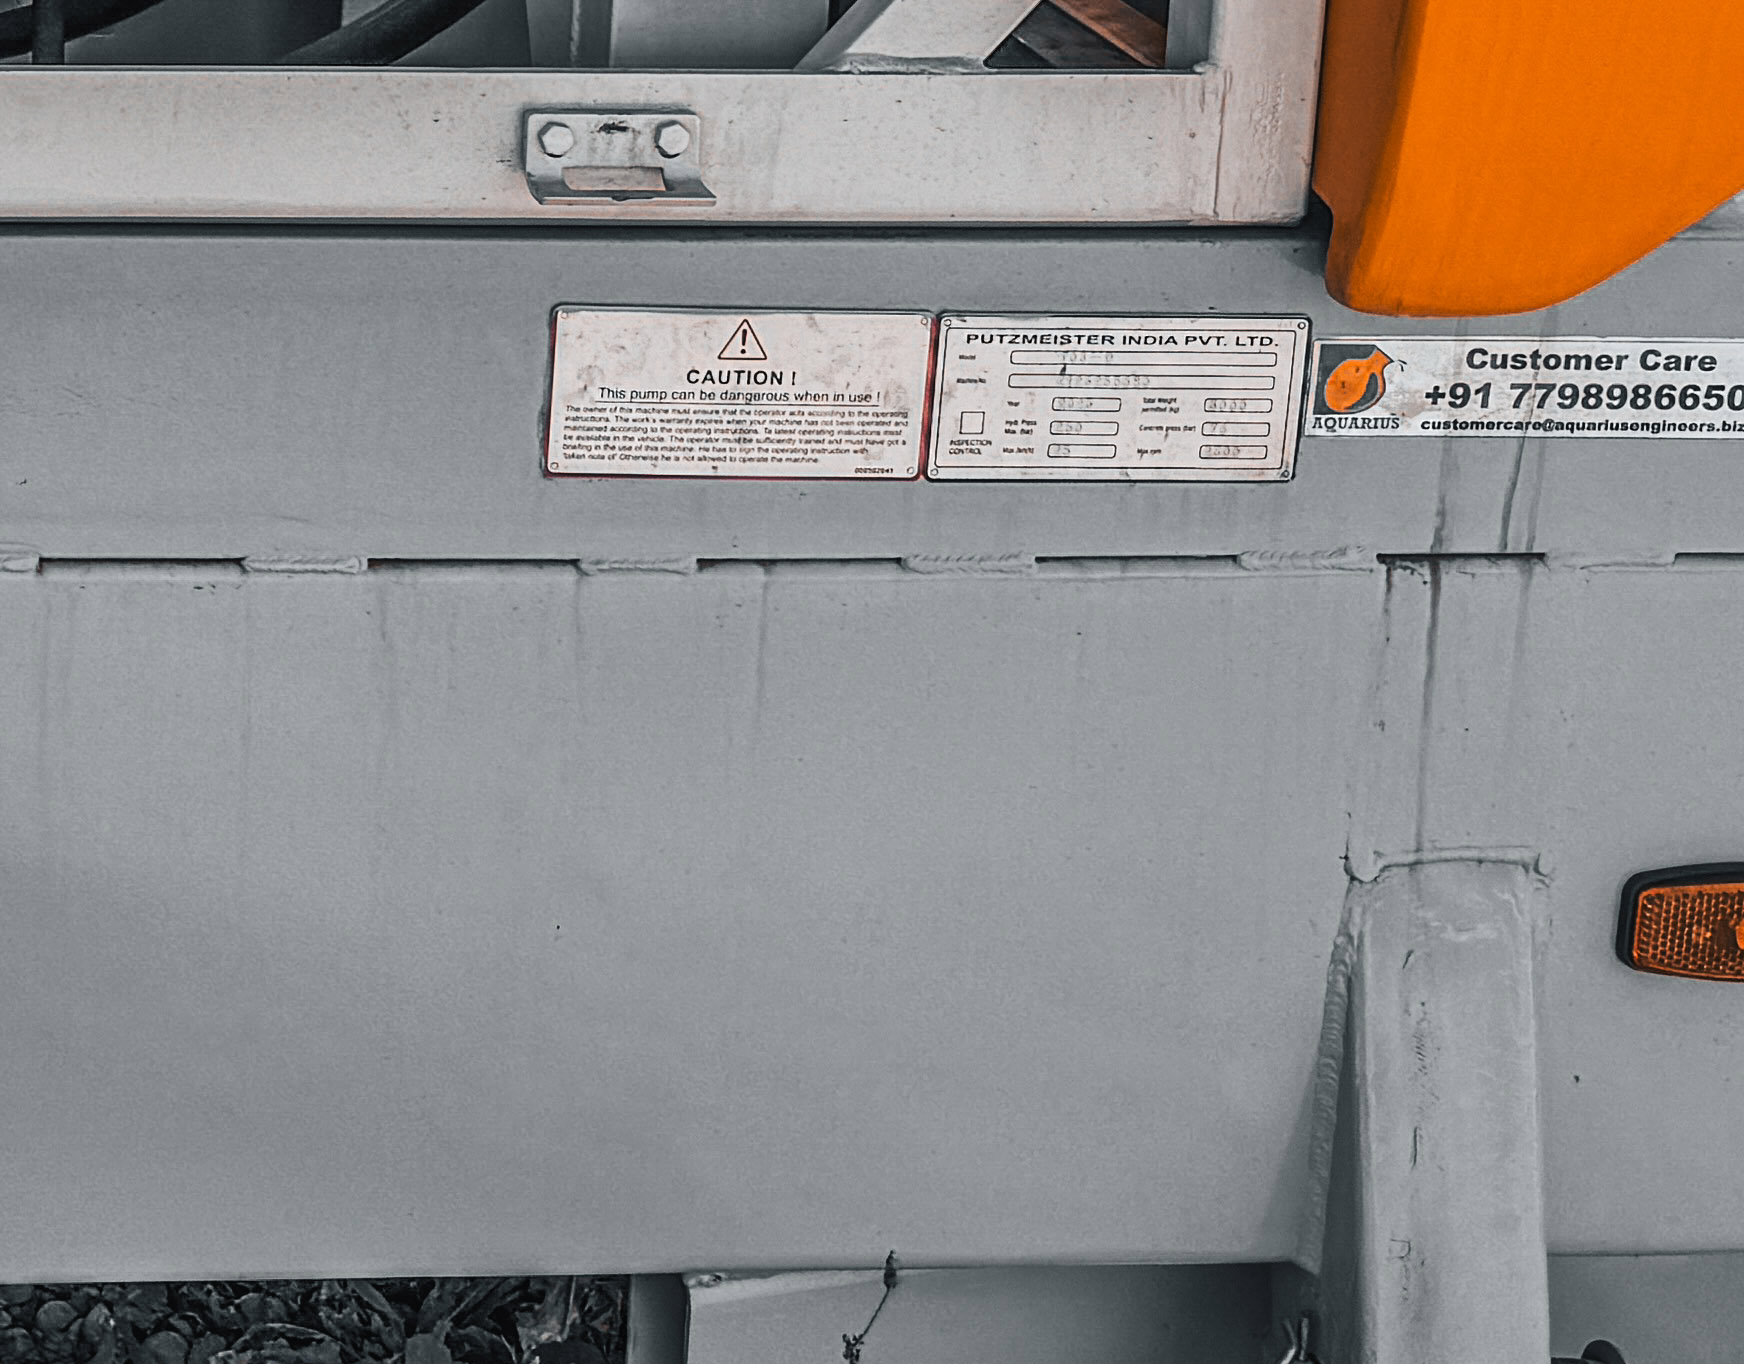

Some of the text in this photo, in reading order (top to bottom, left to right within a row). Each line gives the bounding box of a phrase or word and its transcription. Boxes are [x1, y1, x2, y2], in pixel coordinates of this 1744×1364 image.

[966, 334, 1279, 347] PUTZMEISTER INDIA PVT. LTD.
[1465, 347, 1718, 372] Customer Care
[686, 369, 784, 386] CAUTION
[598, 387, 626, 399] This
[629, 390, 667, 403] pump
[671, 391, 695, 400] can
[699, 390, 715, 400] be
[720, 390, 789, 404] dangerous
[794, 391, 829, 402] when
[833, 391, 844, 402] in
[848, 392, 872, 403] use
[1425, 382, 1744, 411] +91 7798986650
[1312, 417, 1400, 433] AQUARIUS
